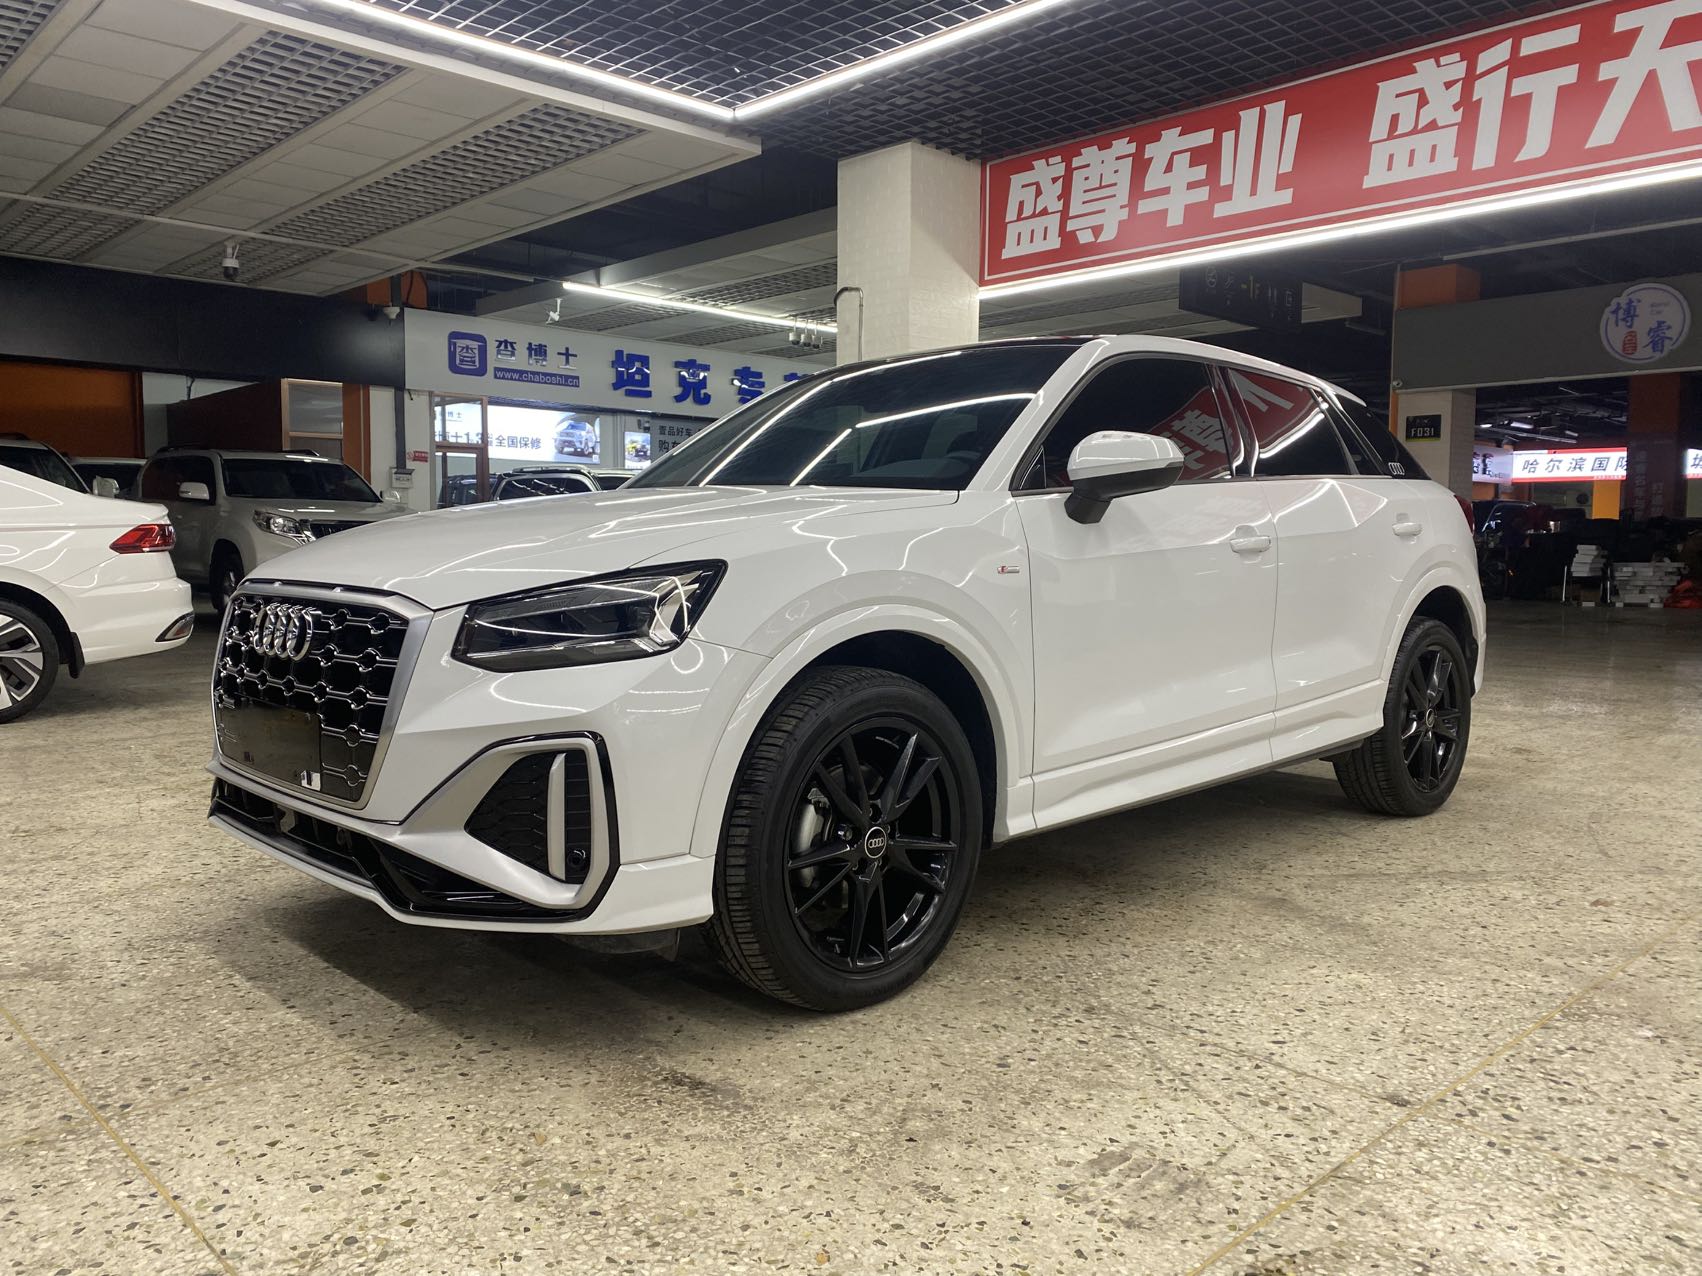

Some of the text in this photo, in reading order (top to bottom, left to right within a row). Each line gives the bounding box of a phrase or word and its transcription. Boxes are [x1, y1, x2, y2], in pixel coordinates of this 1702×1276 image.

[1001, 99, 1303, 260] 盛尊车业
[495, 338, 578, 370] 查博士
[496, 369, 579, 387] www.chaboshi.cn
